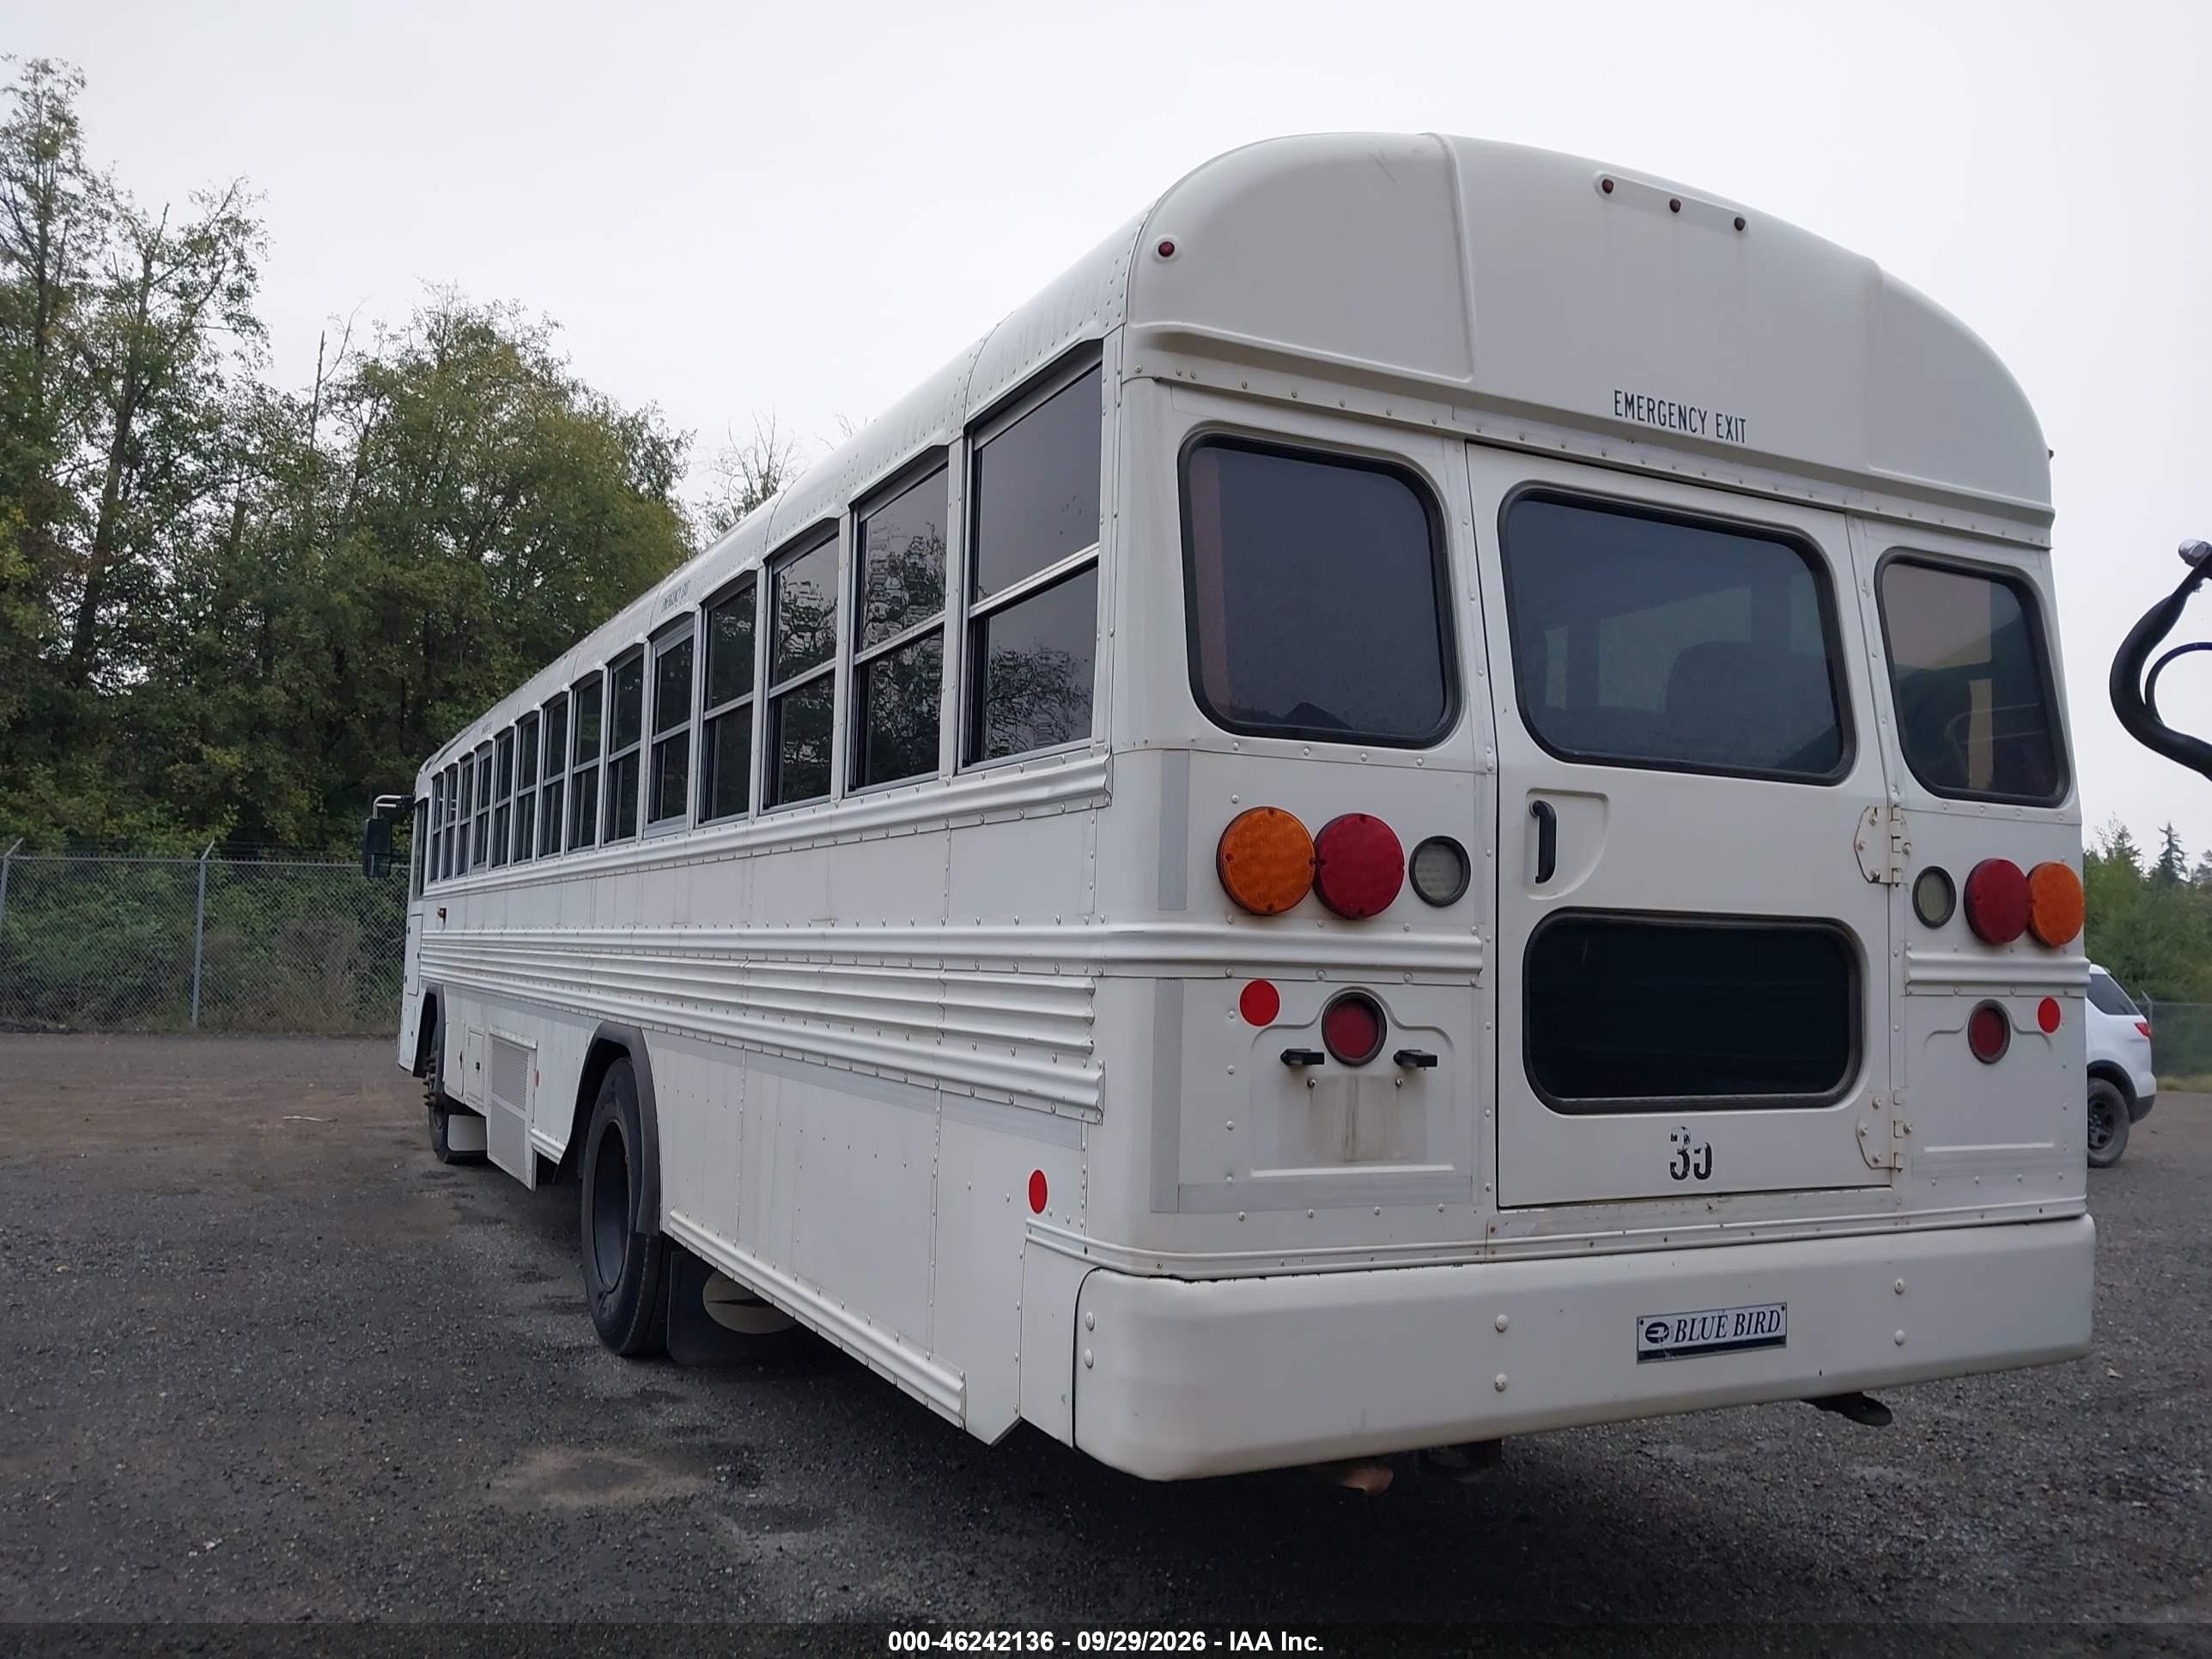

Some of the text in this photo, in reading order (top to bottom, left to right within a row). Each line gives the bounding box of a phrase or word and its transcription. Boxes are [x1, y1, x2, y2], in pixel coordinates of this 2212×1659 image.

[1613, 389, 1747, 444] EMERGENCY EXIT
[1674, 1310, 1781, 1344] BLUE BIRD
